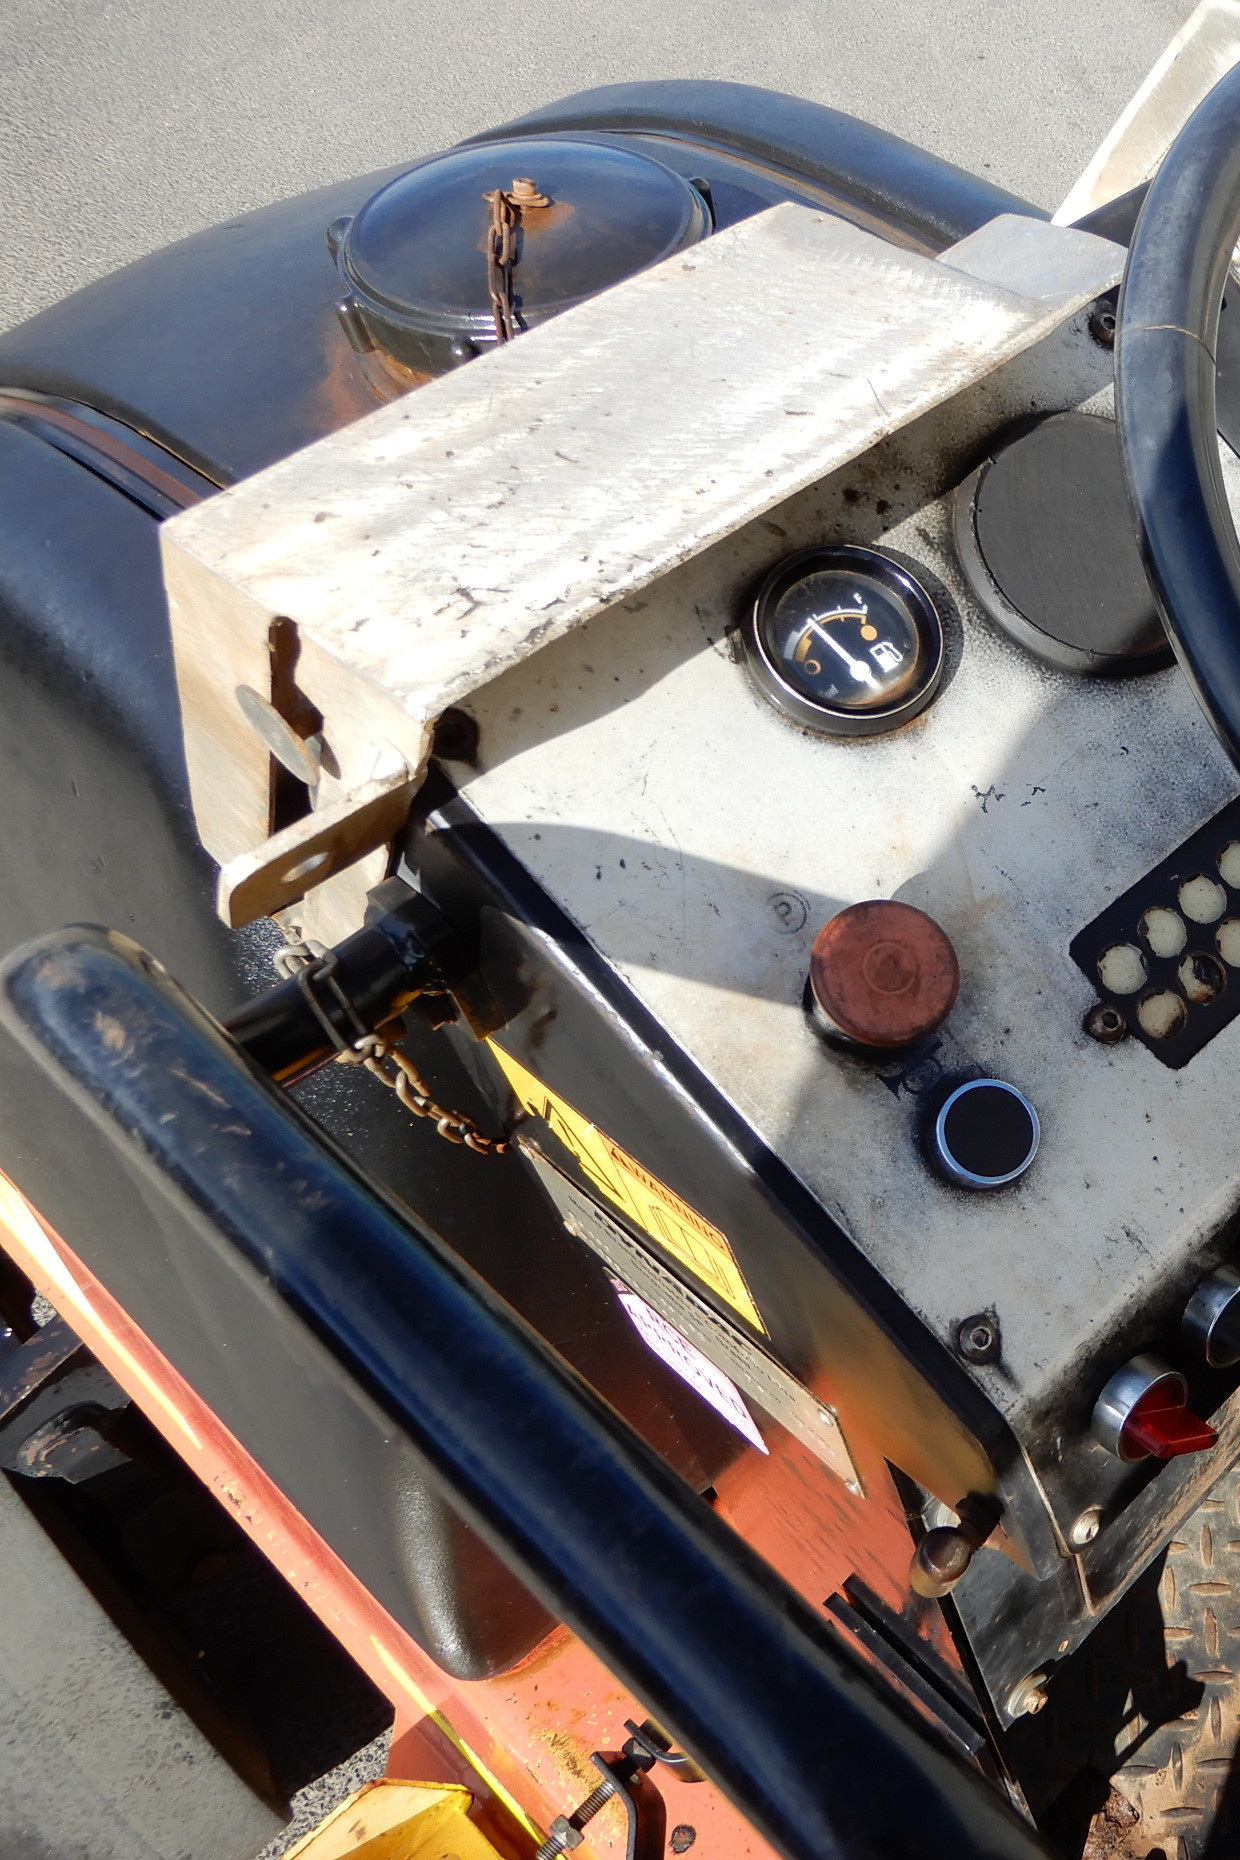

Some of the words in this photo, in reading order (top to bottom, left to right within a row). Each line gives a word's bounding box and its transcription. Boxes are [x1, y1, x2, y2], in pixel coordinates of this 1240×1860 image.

[631, 1162, 726, 1251] WARNING
[592, 1209, 753, 1355] DYNAPAC
[626, 1304, 748, 1420] APPROVED
